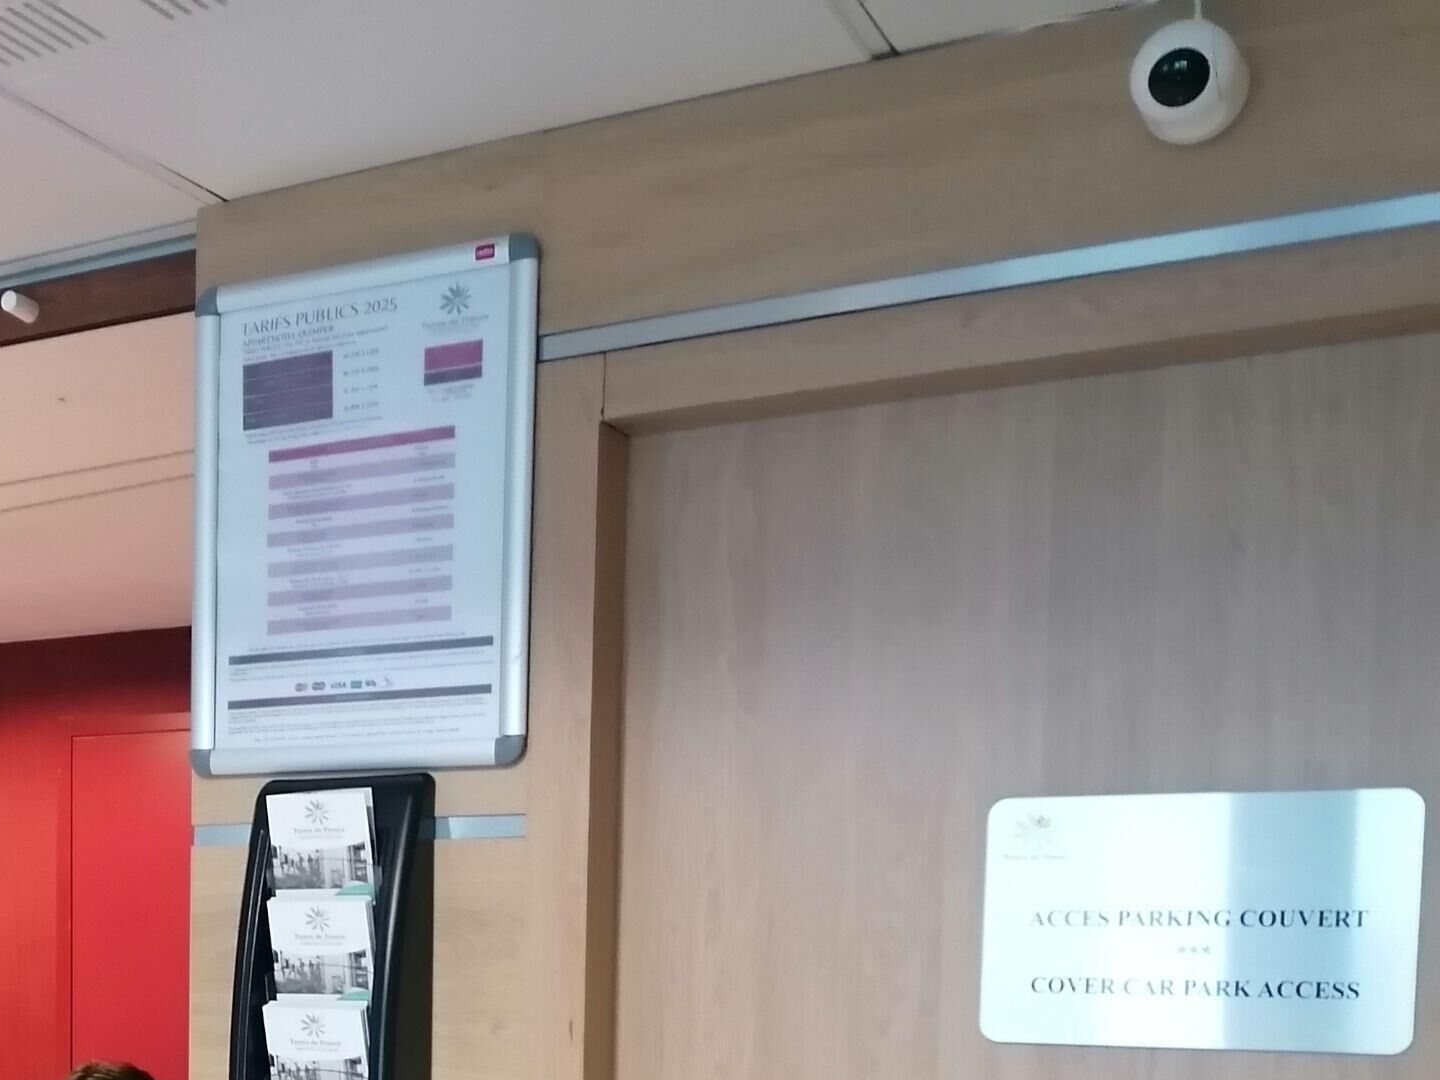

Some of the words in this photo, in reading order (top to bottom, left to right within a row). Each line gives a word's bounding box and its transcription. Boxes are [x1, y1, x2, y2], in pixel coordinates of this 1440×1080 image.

[241, 313, 291, 337] TARIFS
[295, 303, 359, 327] PUBLICS
[363, 297, 398, 315] 2025
[298, 324, 335, 338] QUIMPER
[1030, 910, 1110, 927] ACCES
[1117, 909, 1232, 928] PARKING
[1240, 909, 1369, 928] COUVERT
[1030, 976, 1115, 995] COVER
[1123, 978, 1175, 996] CAR
[1183, 979, 1251, 998] PARK
[1257, 980, 1361, 1000] ACCESS
